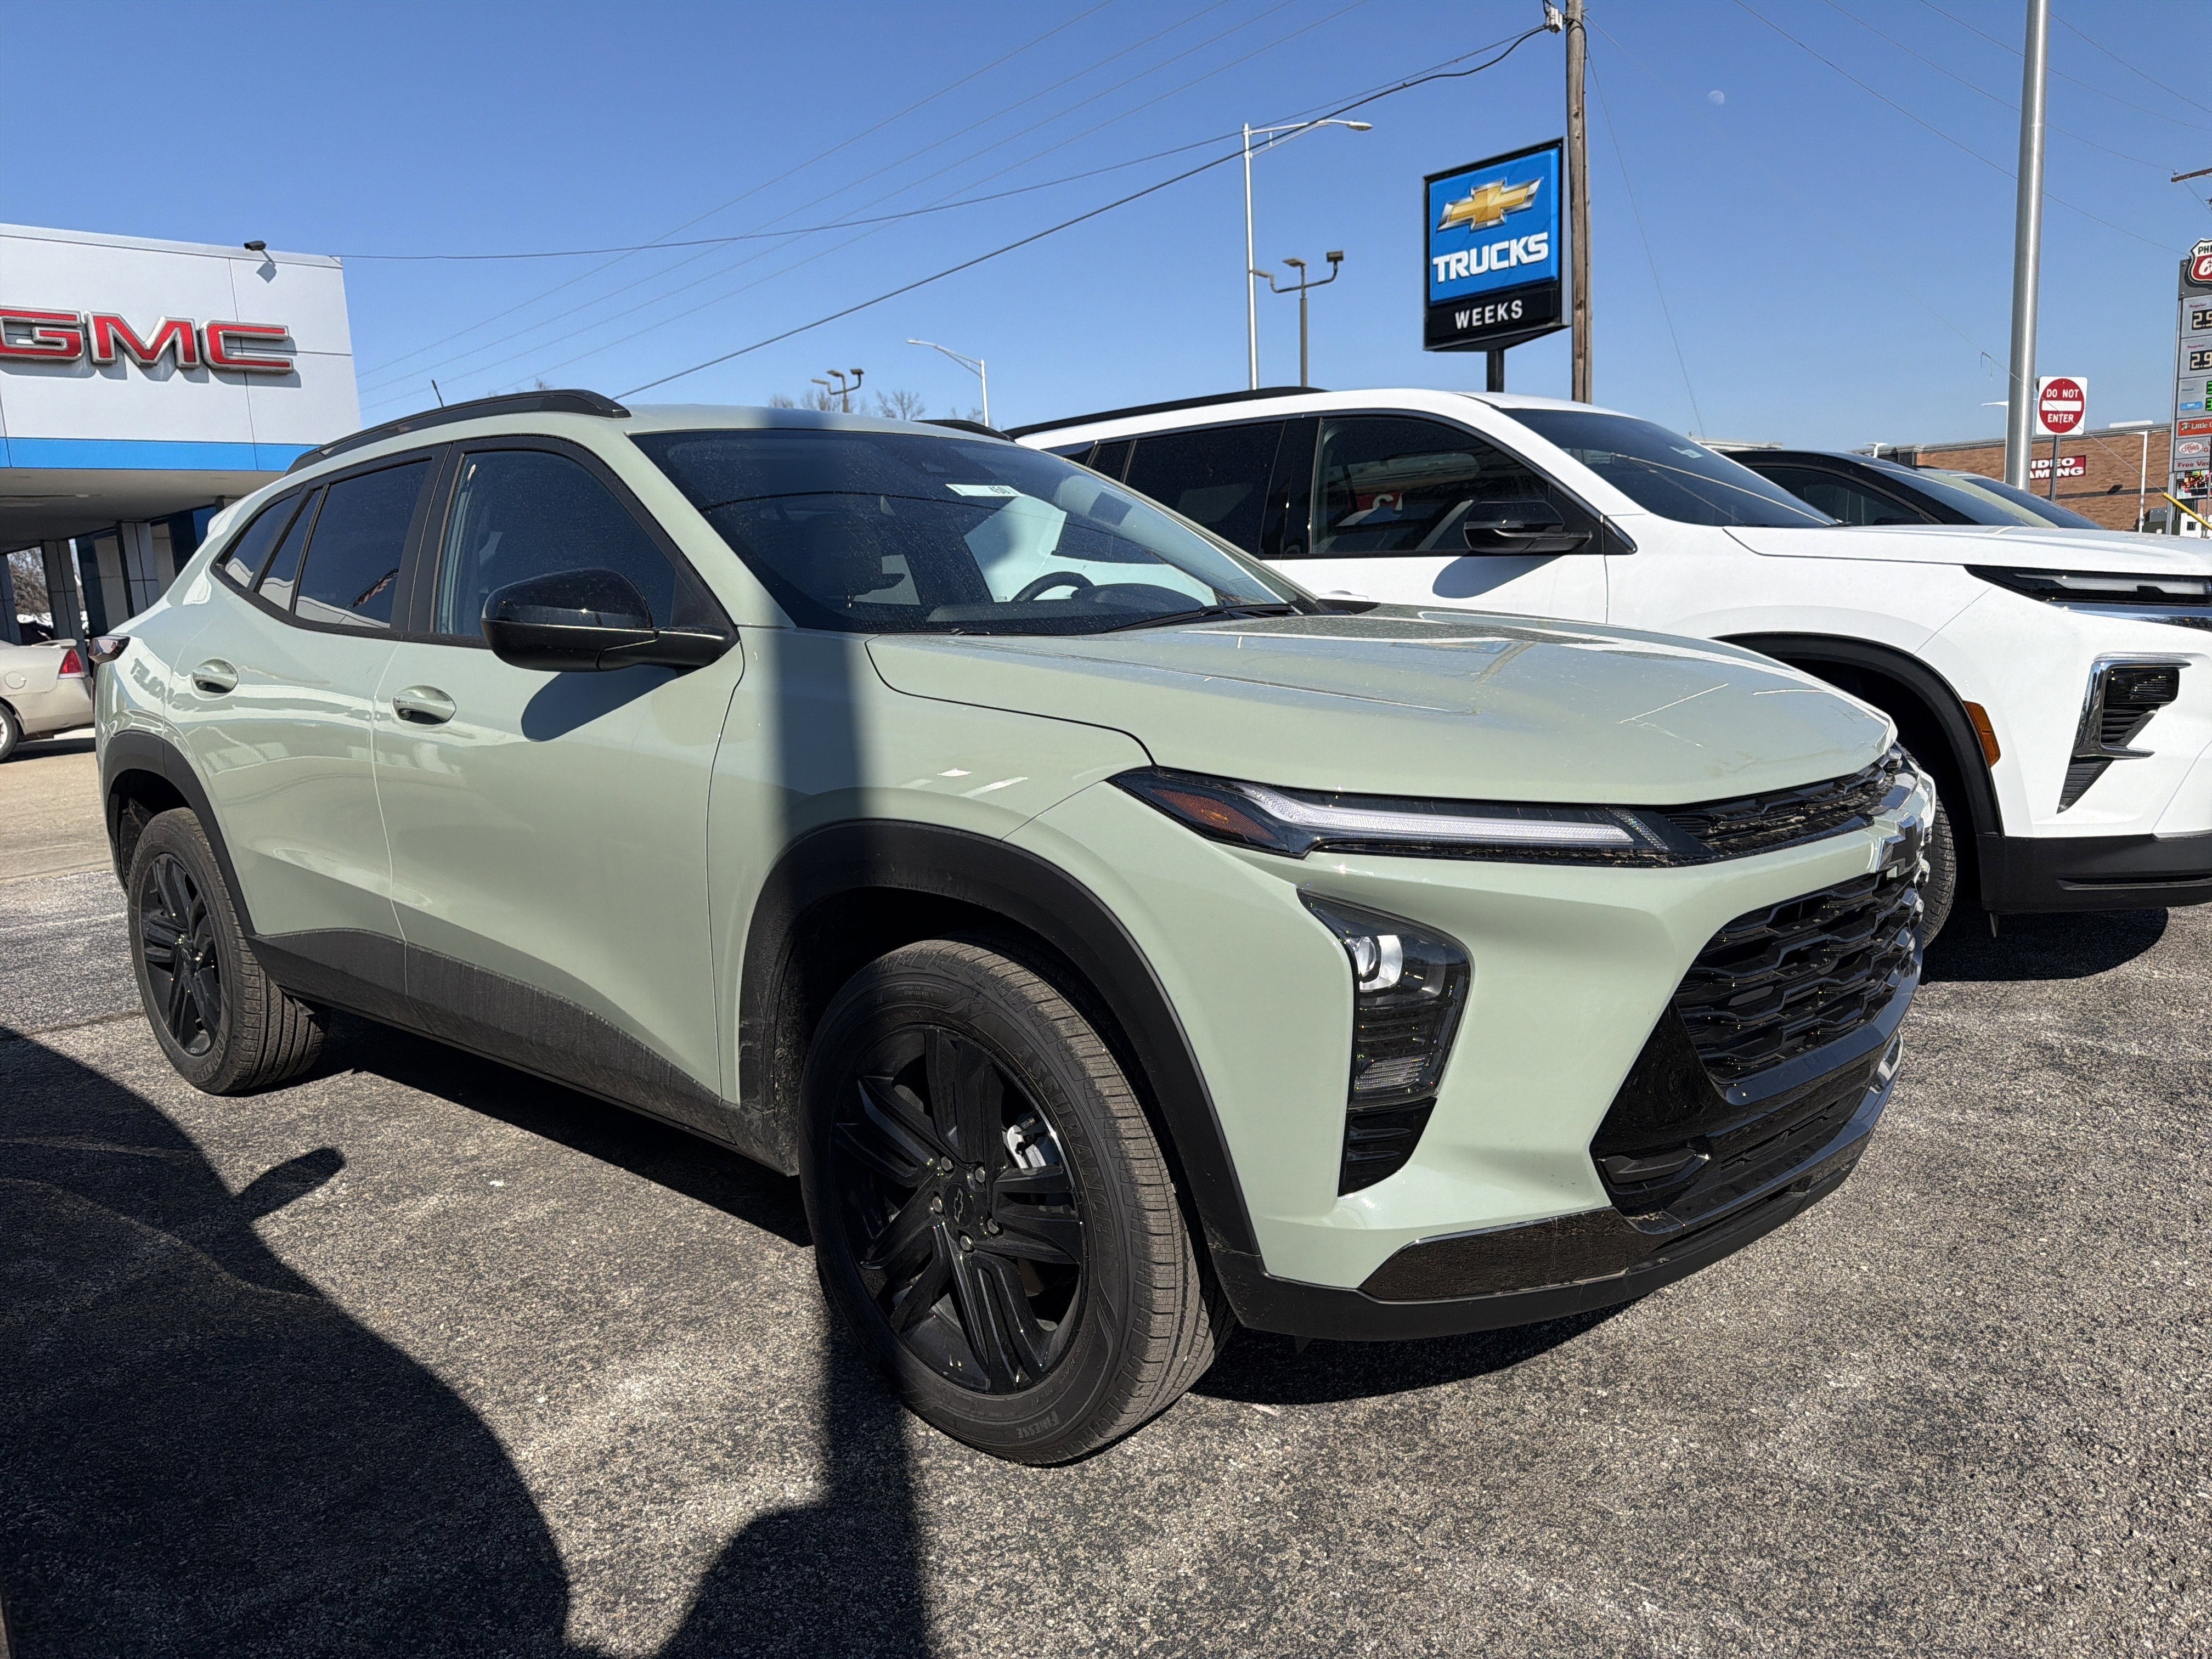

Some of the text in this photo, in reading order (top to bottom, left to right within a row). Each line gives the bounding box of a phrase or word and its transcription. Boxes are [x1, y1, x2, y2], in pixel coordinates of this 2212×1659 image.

[1433, 232, 1548, 283] TRUCKS
[1455, 300, 1523, 329] WEEKS
[0, 306, 294, 373] GMC
[2046, 388, 2079, 398] DO NOT
[2047, 413, 2074, 424] ENTER
[1012, 1043, 1115, 1238] ASSURANCE
[1015, 1409, 1060, 1440] FINESSE
